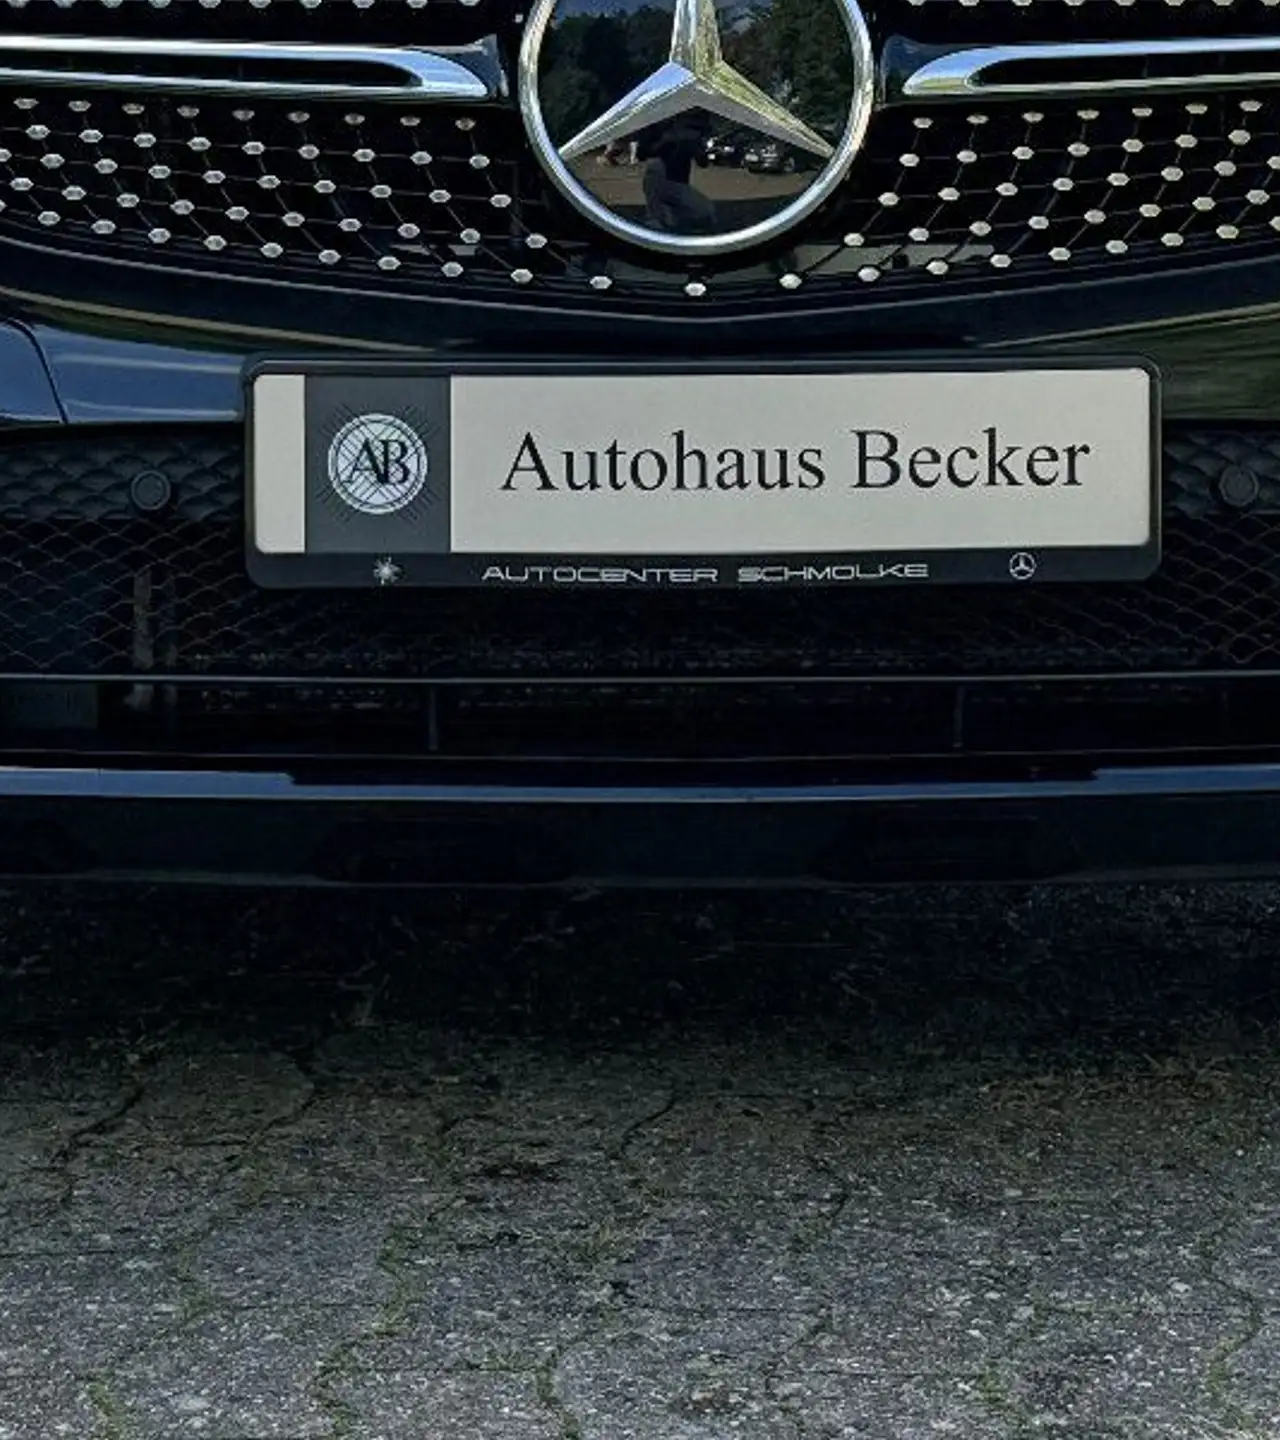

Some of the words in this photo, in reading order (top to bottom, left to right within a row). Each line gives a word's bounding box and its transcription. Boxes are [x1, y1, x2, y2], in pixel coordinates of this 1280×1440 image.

[339, 437, 410, 485] AB
[500, 429, 825, 492] Autohaus
[851, 426, 1090, 490] Becker
[481, 565, 719, 583] AUTOCENTER
[737, 563, 930, 583] SCHMOLKE
